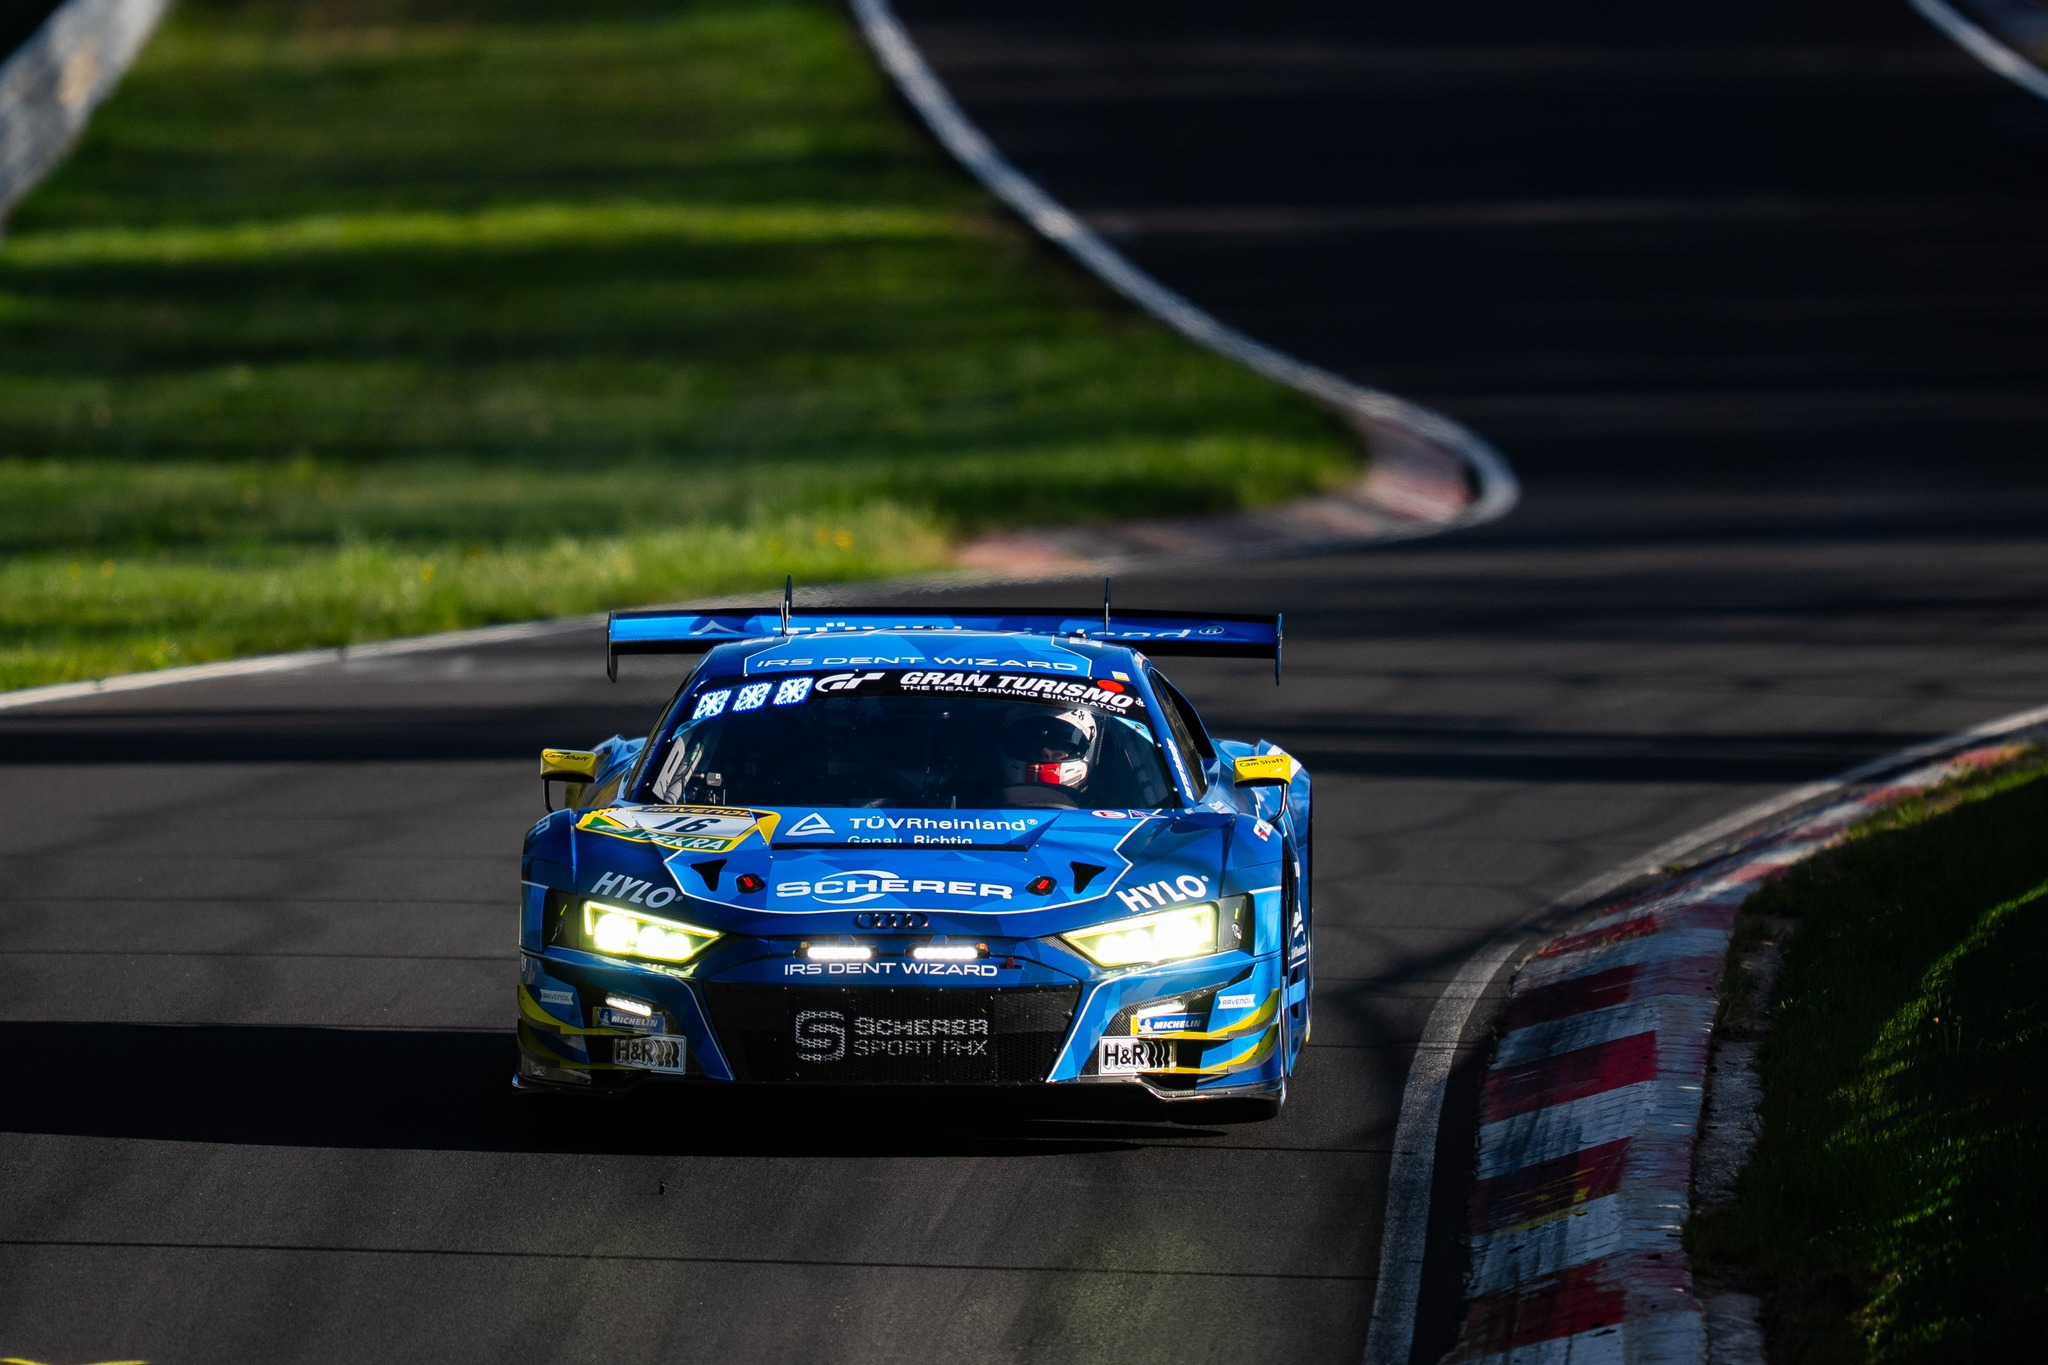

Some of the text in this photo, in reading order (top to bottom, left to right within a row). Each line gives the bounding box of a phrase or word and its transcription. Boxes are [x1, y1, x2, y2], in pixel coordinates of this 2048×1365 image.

[757, 656, 1078, 671] IRS DENT WIZARD
[900, 671, 991, 687] GRAN
[998, 675, 1135, 708] TURISMO
[935, 685, 974, 693] REAL
[977, 687, 1038, 698] DRIVING
[1042, 693, 1127, 715] SIMULATOR
[652, 816, 722, 833] 16
[632, 830, 726, 850] DEKRA
[776, 879, 1013, 900] SCHERER
[784, 962, 998, 977] IRS DENT WIZARD
[1222, 998, 1252, 1006] RAVENOL
[611, 1014, 659, 1028] MICHELIN
[854, 1016, 988, 1036] SCHERER
[1153, 1019, 1201, 1030] MICHELIN
[616, 1039, 654, 1063] H&R
[853, 1039, 988, 1056] SPORT PHX
[1103, 1044, 1145, 1066] H&R
